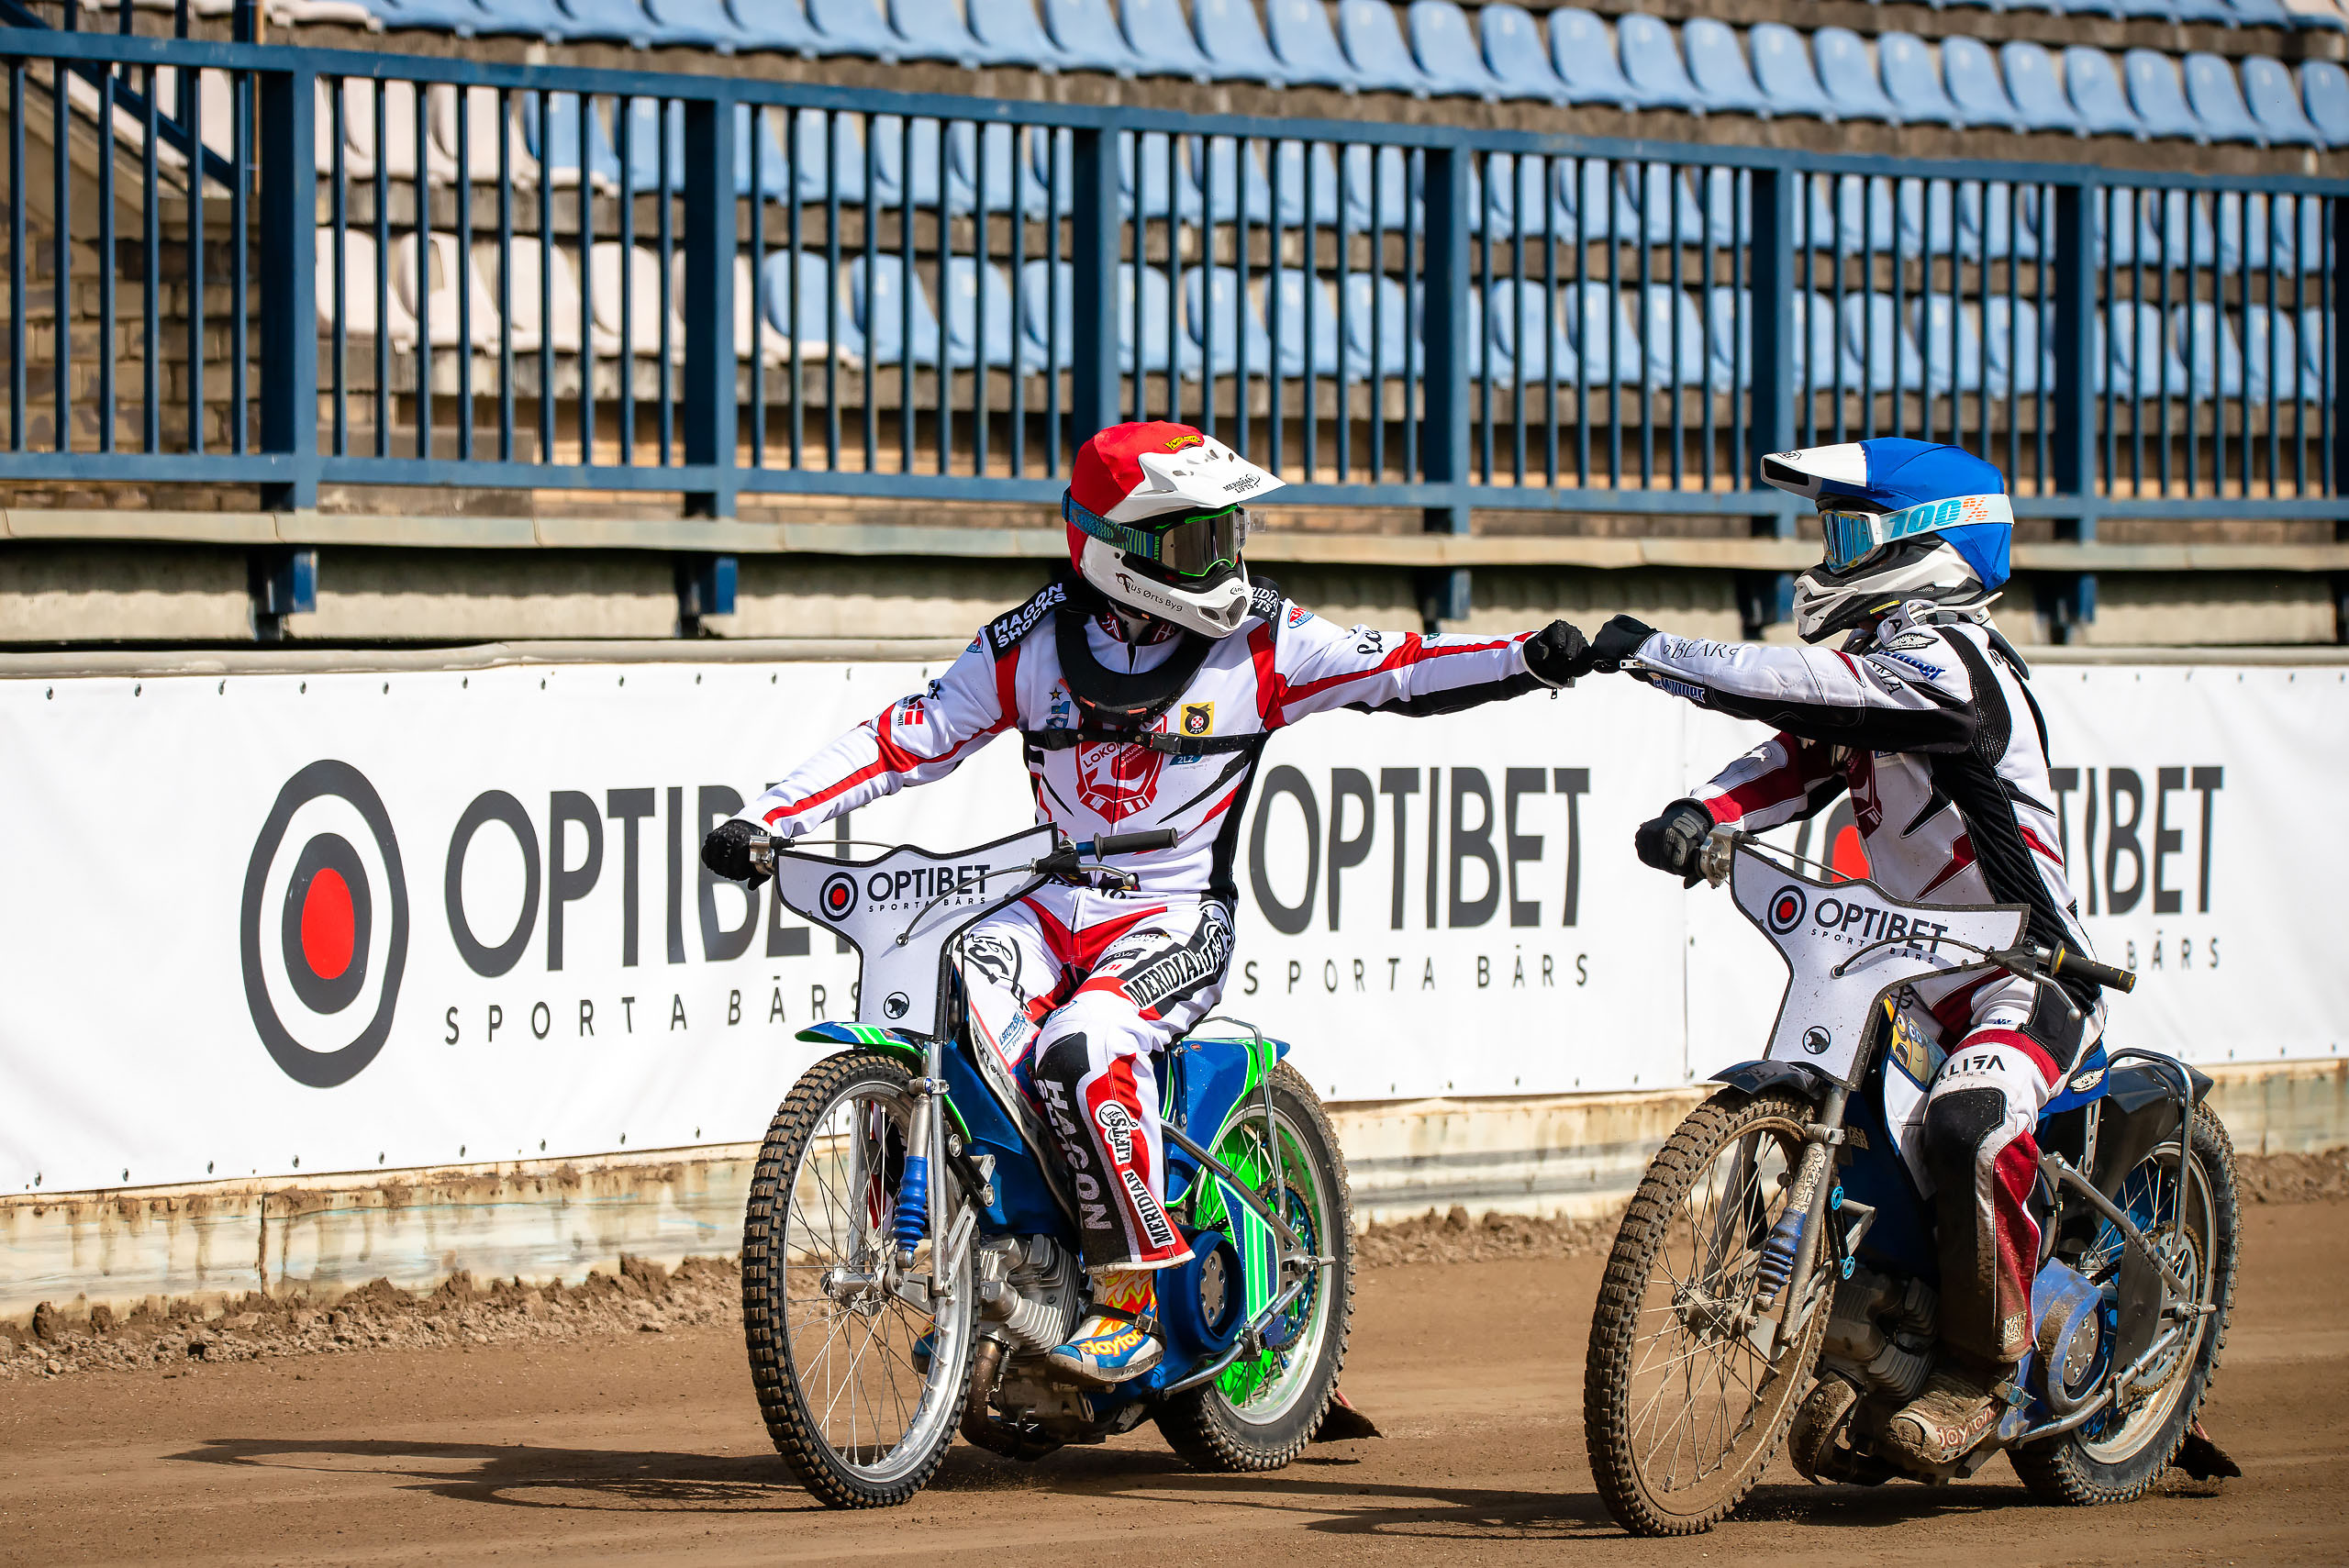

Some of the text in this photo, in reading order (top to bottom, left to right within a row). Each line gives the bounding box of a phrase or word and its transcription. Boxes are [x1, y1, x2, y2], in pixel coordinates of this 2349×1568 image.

[1235, 484, 1254, 494] LIFTS
[1887, 496, 1989, 539] 100%
[994, 583, 1063, 639] HAGON
[997, 592, 1067, 648] SHOCKS
[1142, 589, 1163, 605] Ørts
[1164, 599, 1184, 612] Byg
[1670, 641, 1728, 660] BEAR
[1249, 764, 1590, 935] OPTIBET
[867, 864, 991, 902] OPTIBET
[943, 896, 985, 906] BĀRS
[1810, 928, 1934, 964] SPORT BĀRS
[1815, 897, 1949, 954] OPTIBET
[1244, 944, 1588, 995] SPORTA BĀRS
[445, 994, 687, 1045] SPORTA
[1044, 1079, 1113, 1230] HAGON
[1124, 1172, 1174, 1245] MERIDIAN
